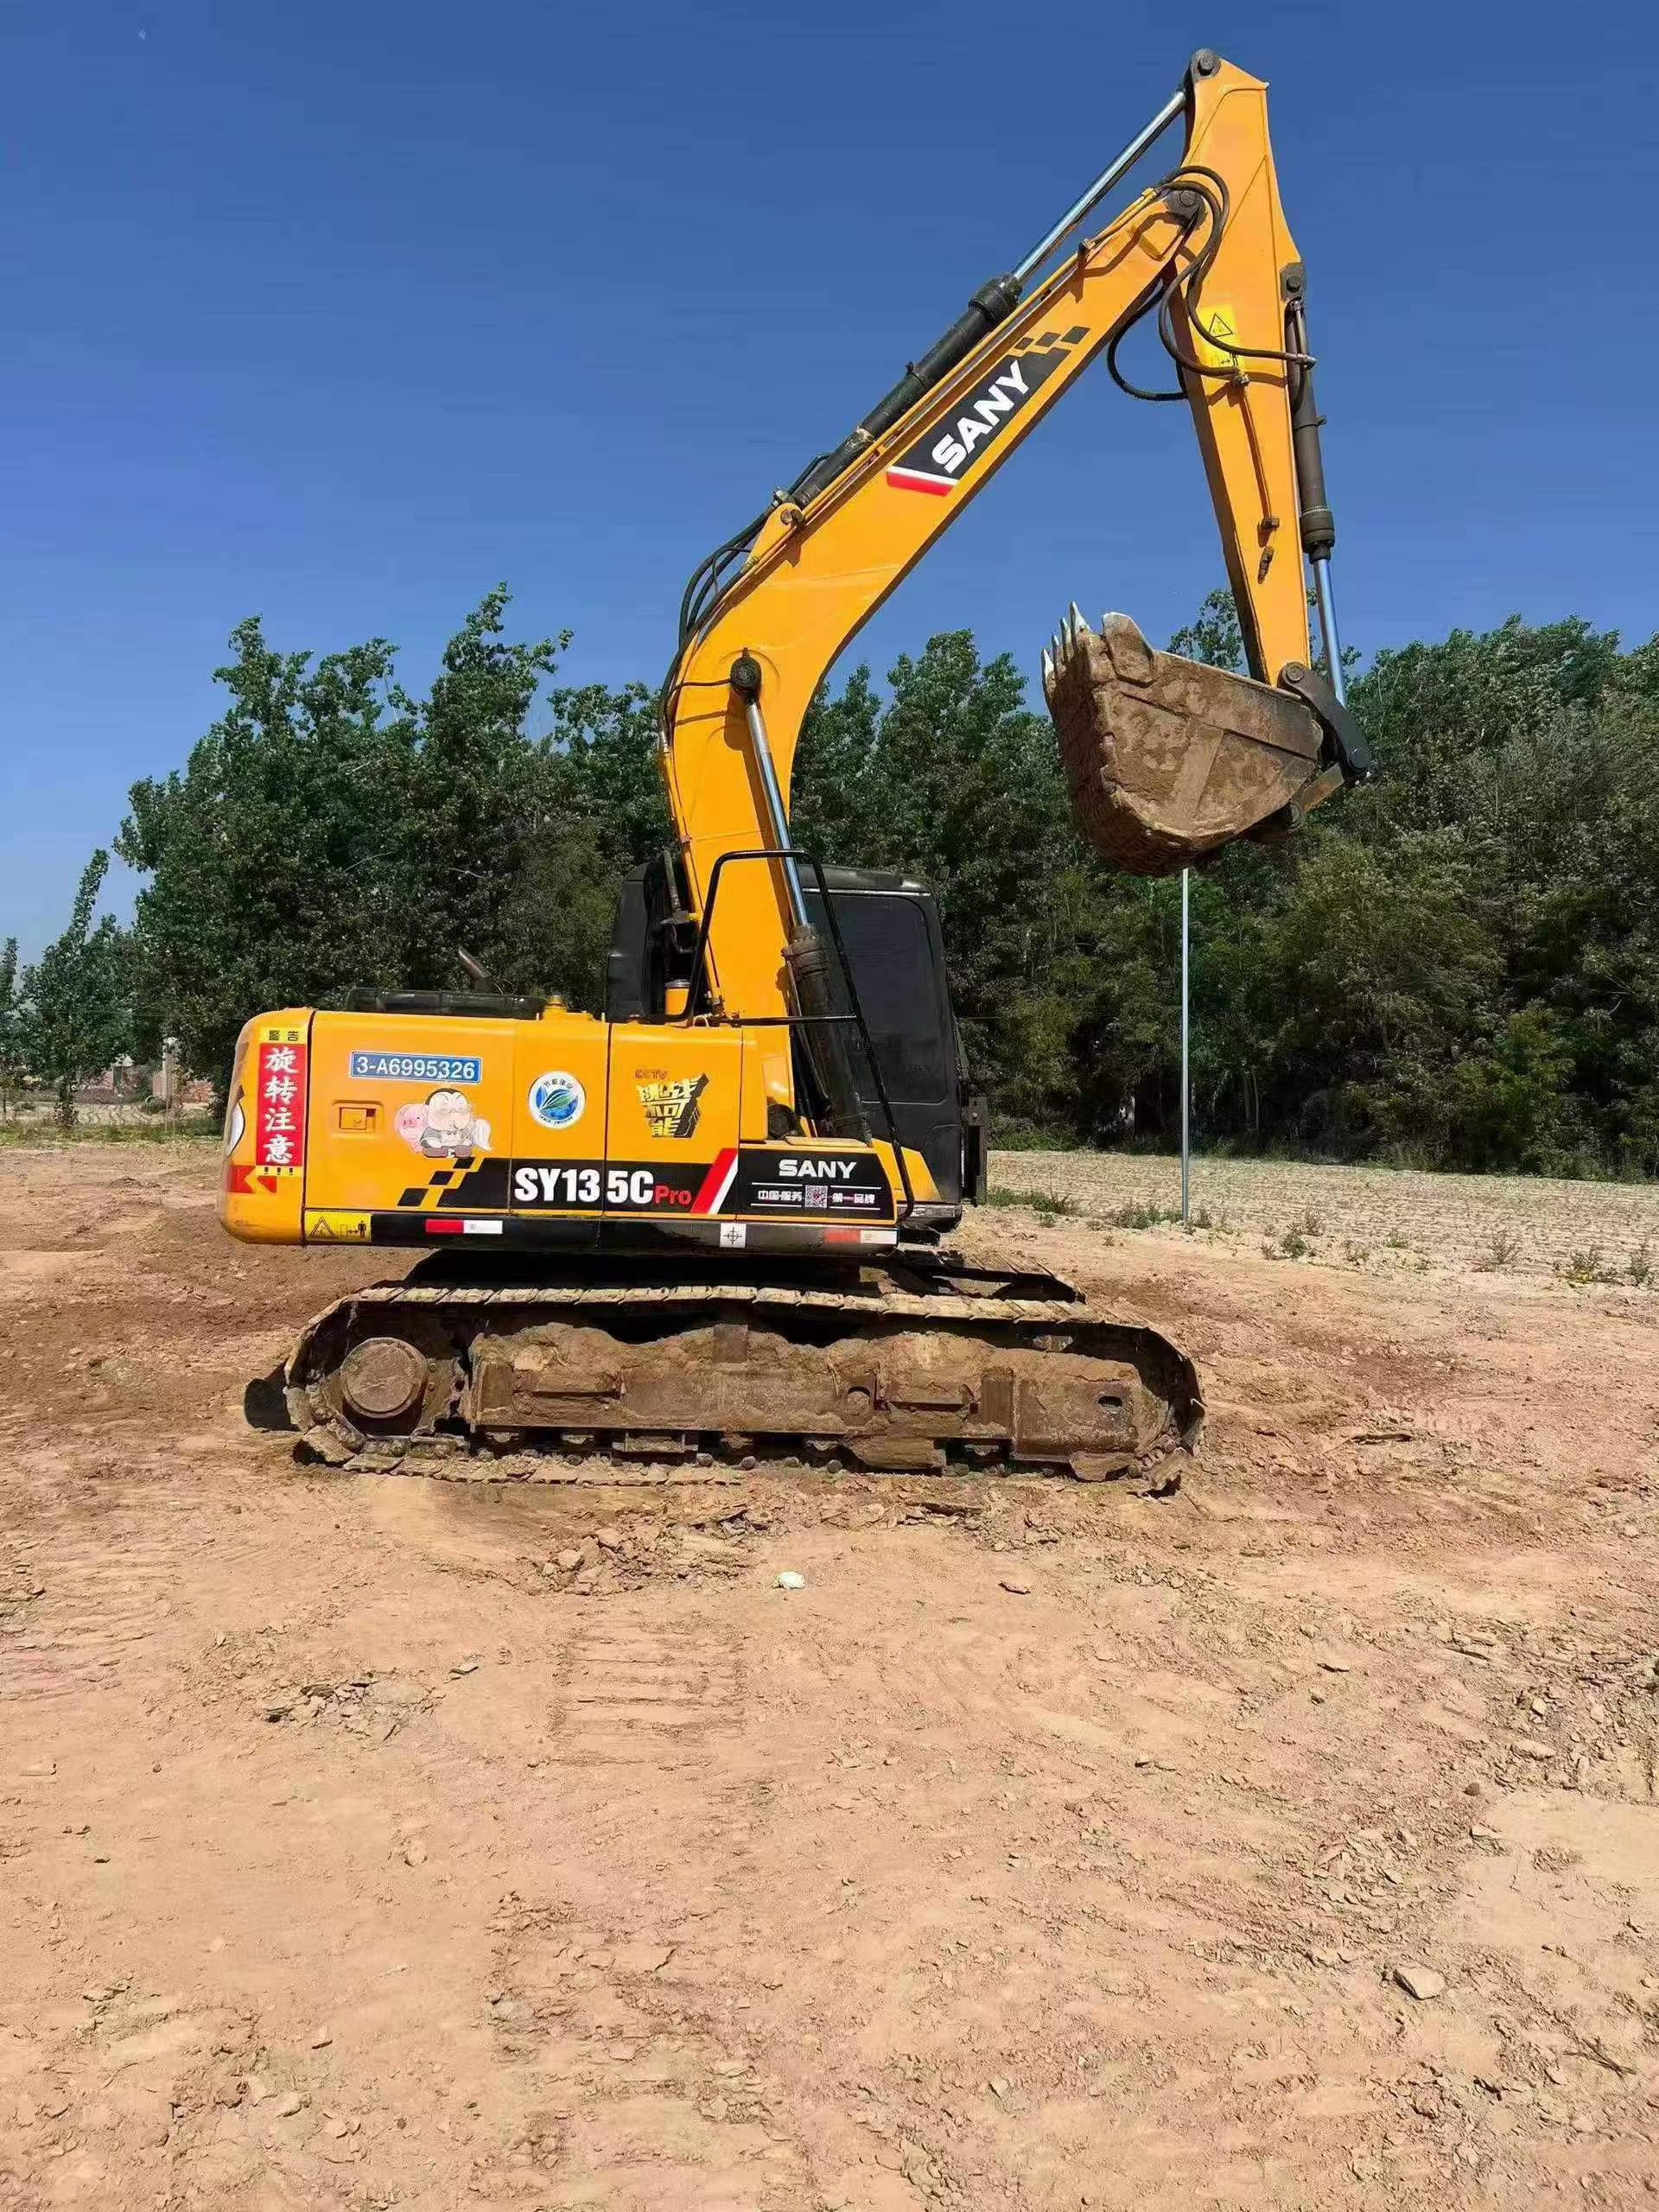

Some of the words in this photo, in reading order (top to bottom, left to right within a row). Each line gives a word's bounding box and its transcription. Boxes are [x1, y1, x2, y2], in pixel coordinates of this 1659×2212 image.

[931, 359, 1029, 474] SANY
[357, 1056, 475, 1079] 3-A6995326
[263, 1046, 298, 1165] 旋转注意
[779, 1159, 857, 1179] SANY
